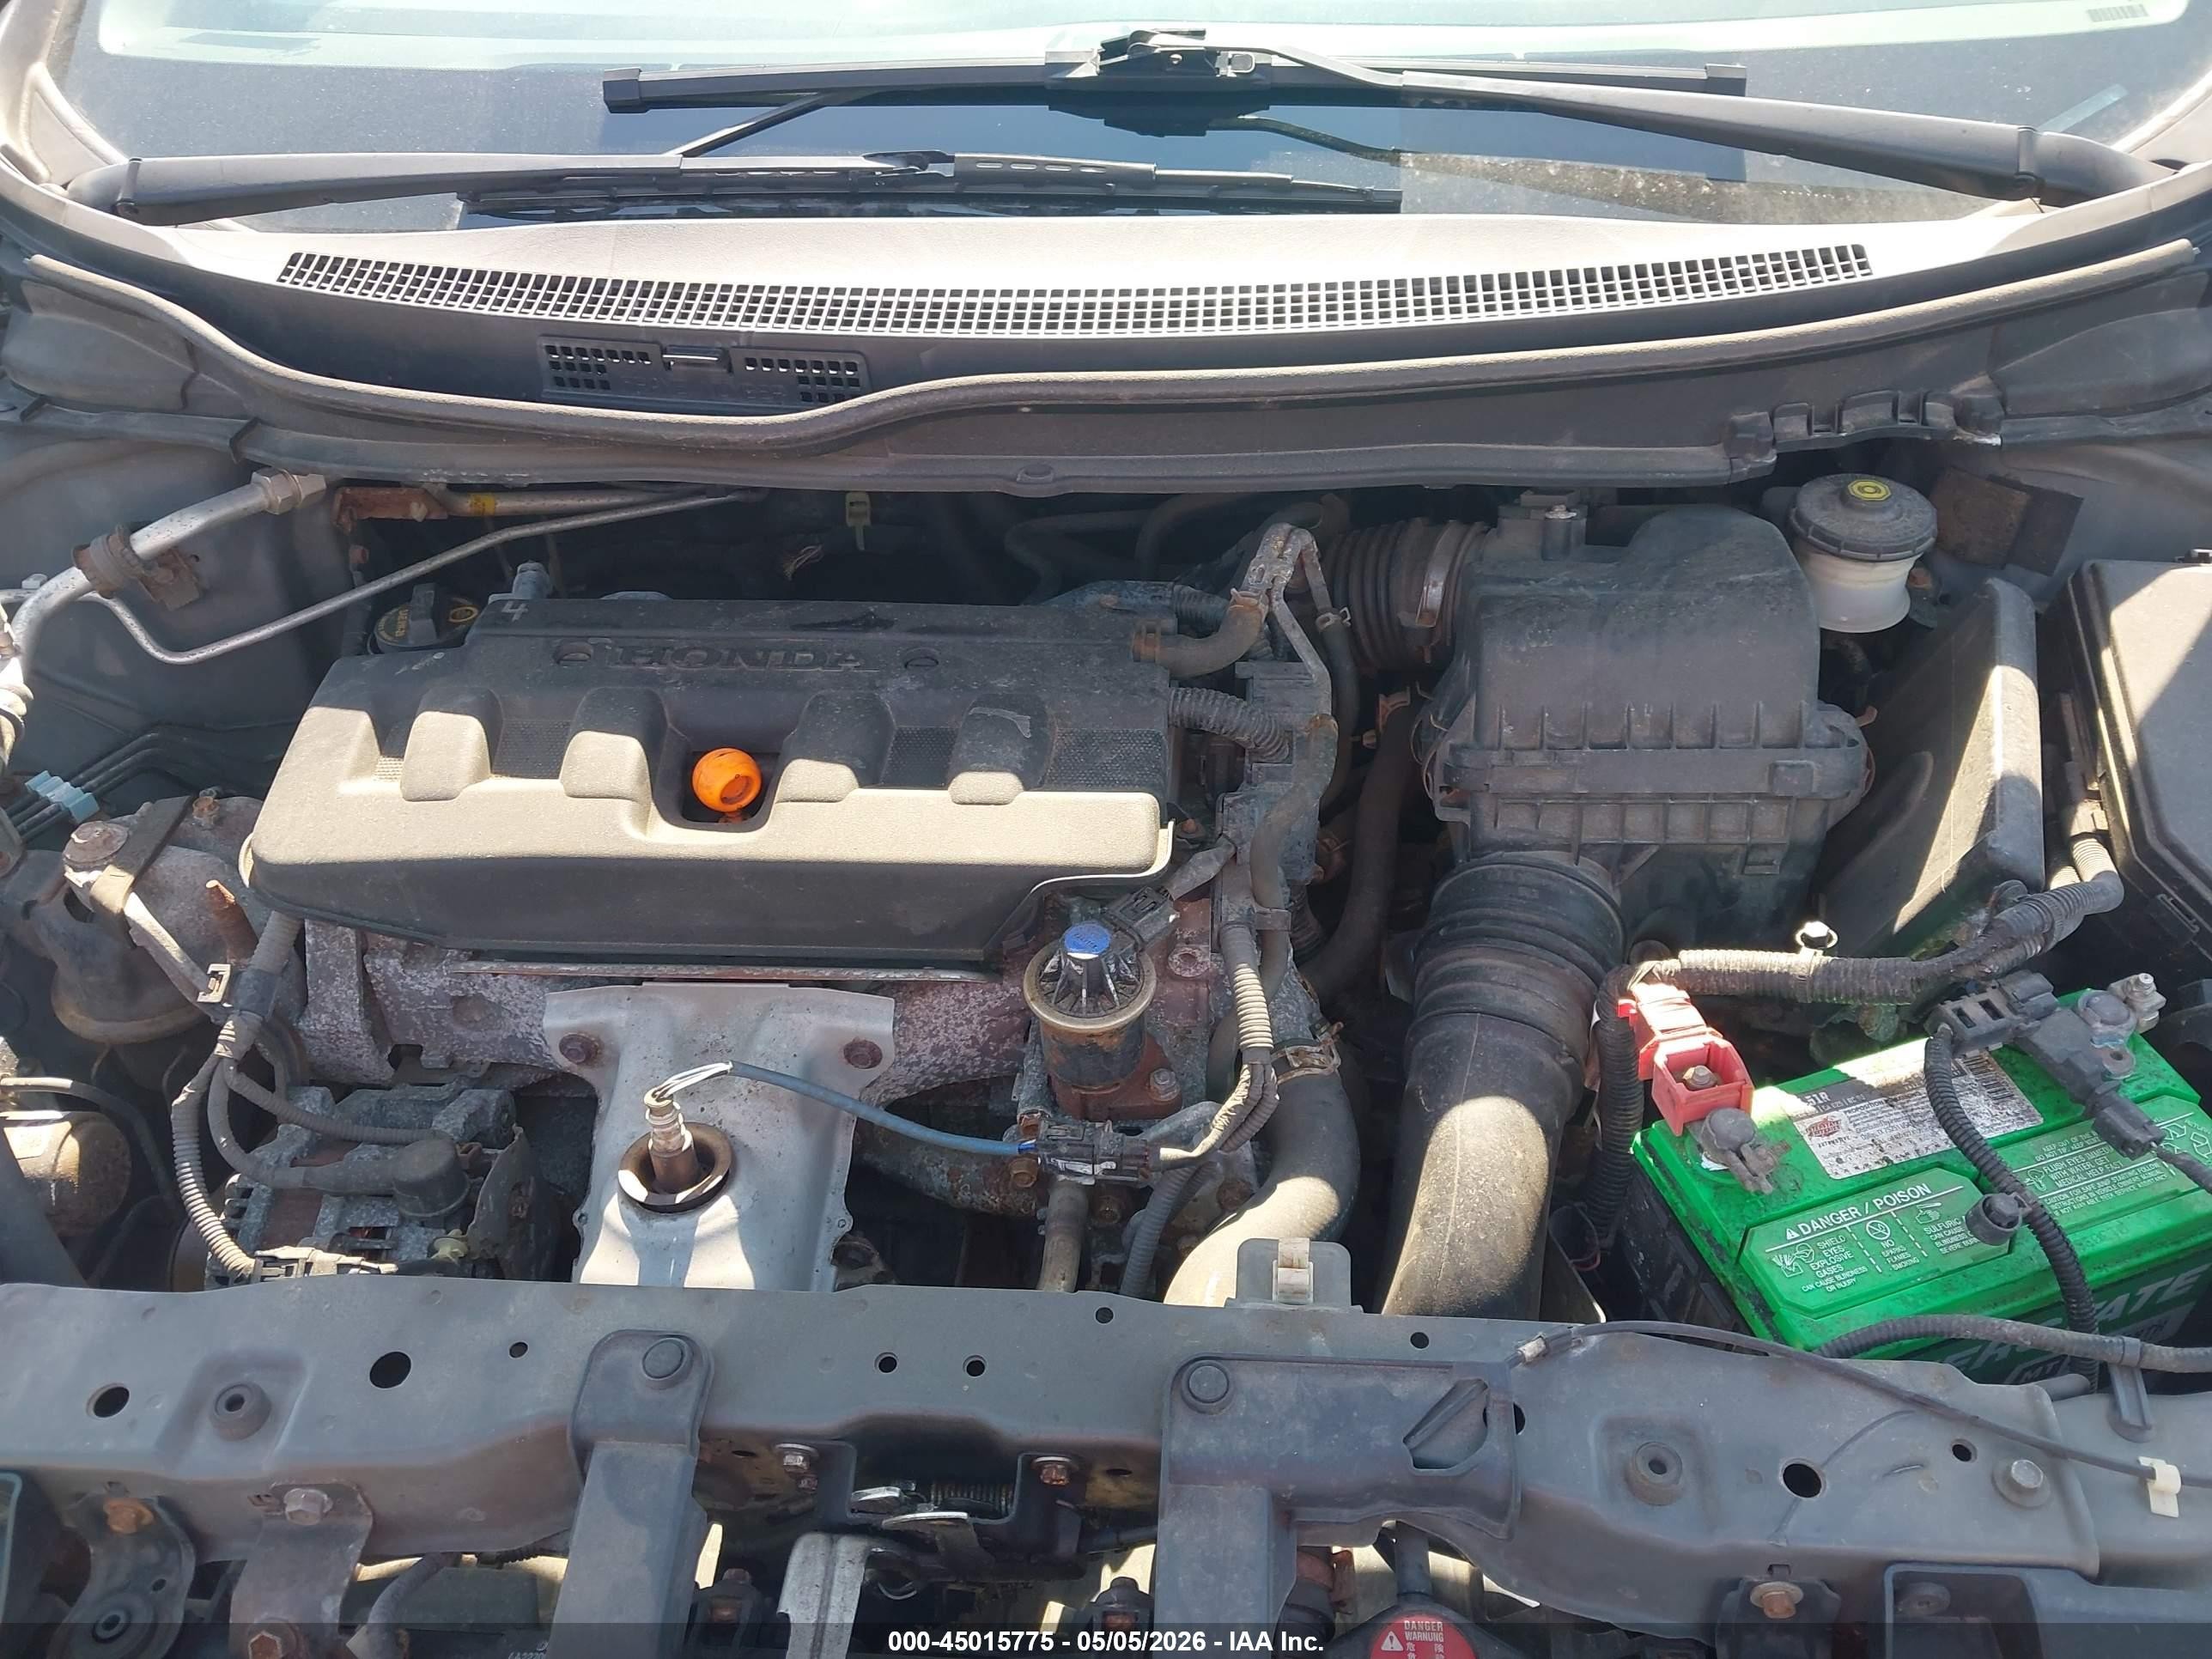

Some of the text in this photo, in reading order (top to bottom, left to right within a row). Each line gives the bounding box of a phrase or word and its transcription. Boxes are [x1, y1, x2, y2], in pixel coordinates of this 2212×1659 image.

[607, 645, 879, 672] HONDA
[2042, 1160, 2067, 1174] FLUSH
[2066, 1155, 2086, 1166] EYES
[2048, 1170, 2069, 1182] WITH
[2095, 1156, 2110, 1165] GET
[2055, 1174, 2087, 1188] MEDICAL
[2087, 1167, 2104, 1178] HELP
[2081, 1184, 2096, 1193] SAFE
[1797, 1182, 1931, 1235] DANGER / POISON
[1923, 1218, 1961, 1234] SULFURIC
[1930, 1231, 1944, 1240] CAN
[1943, 1225, 1965, 1237] CAUSE
[1817, 1235, 1845, 1249] SHIELD
[1881, 1239, 1894, 1249] NO
[1935, 1233, 1967, 1247] BLINDNESS
[1822, 1245, 1844, 1257] EYES
[1882, 1245, 1906, 1257] SPARKS
[1940, 1242, 1964, 1255] SEVERE
[1809, 1250, 1854, 1270] EXPLOSIVE
[1892, 1257, 1919, 1270] SMOKING
[1815, 1264, 1844, 1278] GASES
[1802, 1266, 1868, 1291] CAN CAUSE BLINDNESS
[1836, 1278, 1856, 1290] INJURY
[1404, 1620, 1443, 1632] DANGER
[1405, 1631, 1444, 1642] WARNUNG
